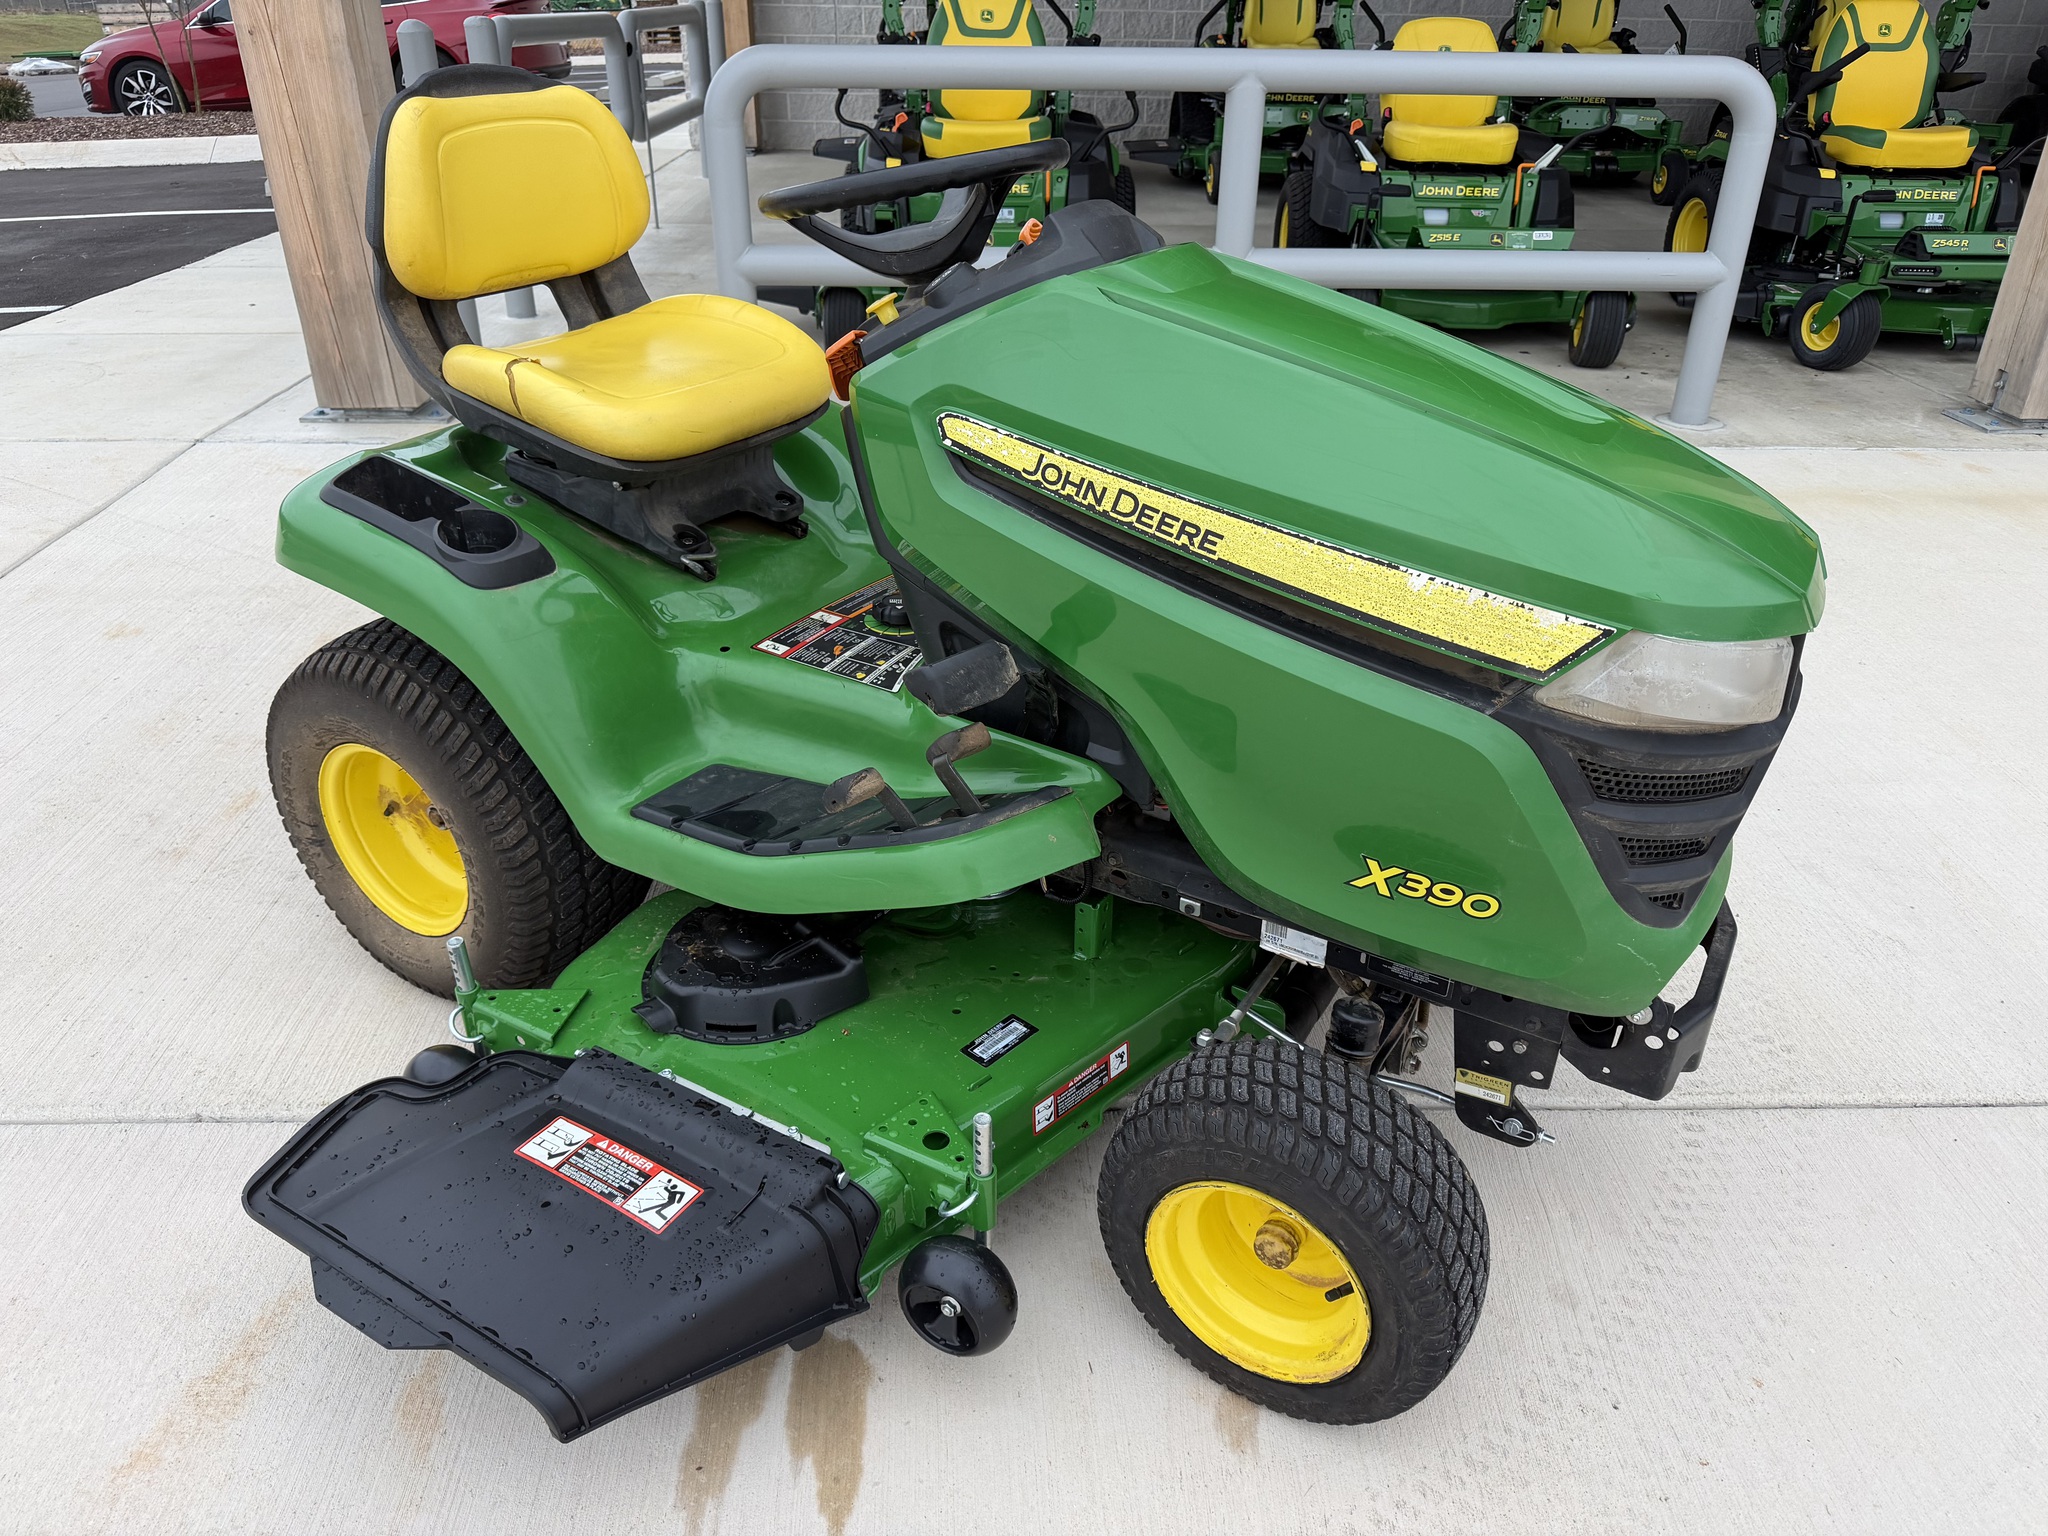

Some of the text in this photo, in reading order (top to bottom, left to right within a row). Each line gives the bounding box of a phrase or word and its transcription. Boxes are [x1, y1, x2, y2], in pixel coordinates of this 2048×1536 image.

[1285, 93, 1315, 102] DEERE
[1418, 184, 1500, 197] JOHN DEERE
[1914, 189, 1957, 200] DEERE
[1428, 233, 1461, 243] Z515 E
[1931, 239, 1960, 248] Z545
[1022, 453, 1225, 557] JOHN DEERE
[1344, 853, 1502, 920] X390
[1073, 1063, 1097, 1084] DANGER
[593, 1148, 639, 1173] ROTATING BLADE
[607, 1143, 654, 1172] DANGER
